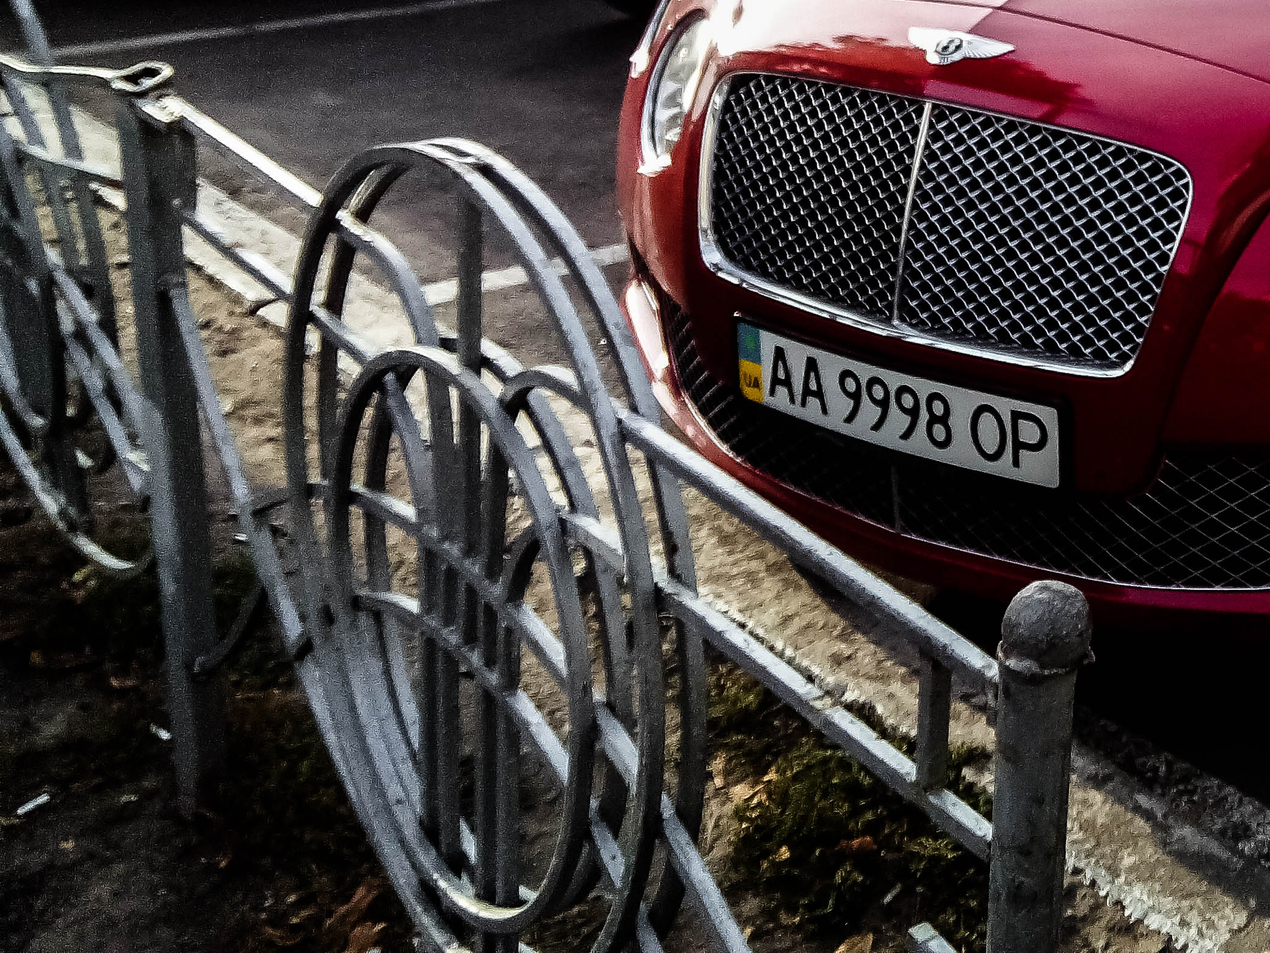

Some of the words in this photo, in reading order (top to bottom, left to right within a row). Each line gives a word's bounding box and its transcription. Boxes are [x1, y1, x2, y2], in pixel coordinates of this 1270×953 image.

[743, 371, 762, 391] UA
[768, 345, 829, 416] AA
[838, 369, 952, 450] 9998
[970, 404, 1048, 469] OP
